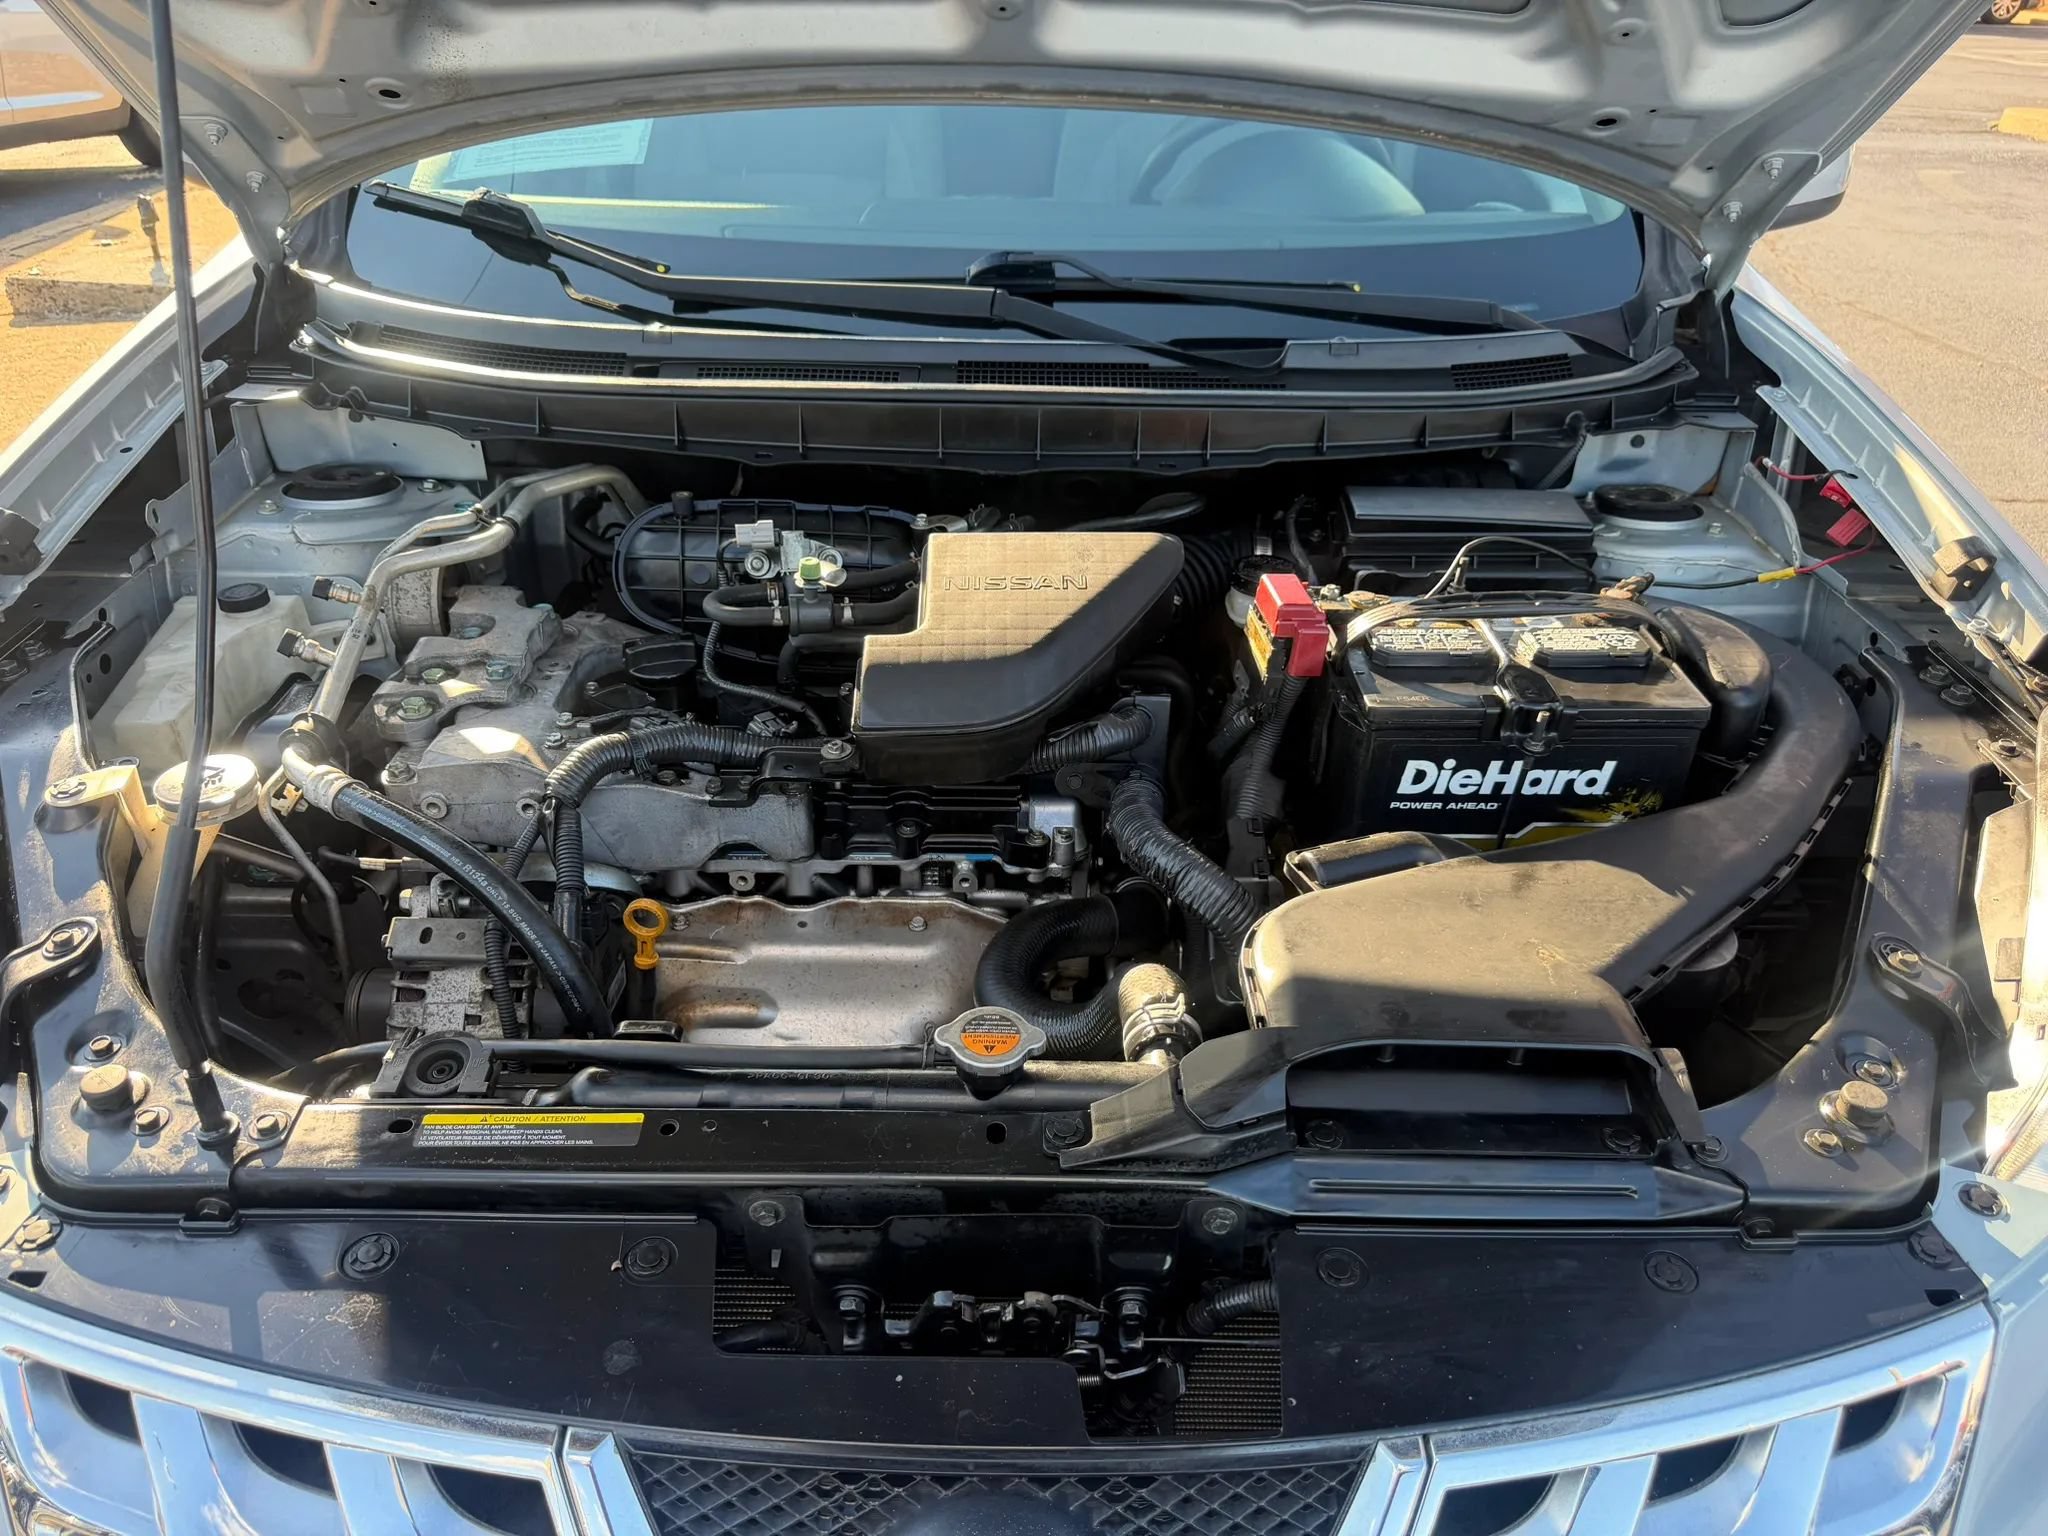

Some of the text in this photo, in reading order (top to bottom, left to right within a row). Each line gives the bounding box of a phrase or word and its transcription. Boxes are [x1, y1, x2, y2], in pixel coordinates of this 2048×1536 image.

[944, 575, 1088, 591] NISSAN
[1397, 759, 1617, 795] DieHard
[1389, 801, 1498, 810] POWER AHEAD
[520, 921, 537, 940] MADE
[541, 948, 559, 970] JAPAN
